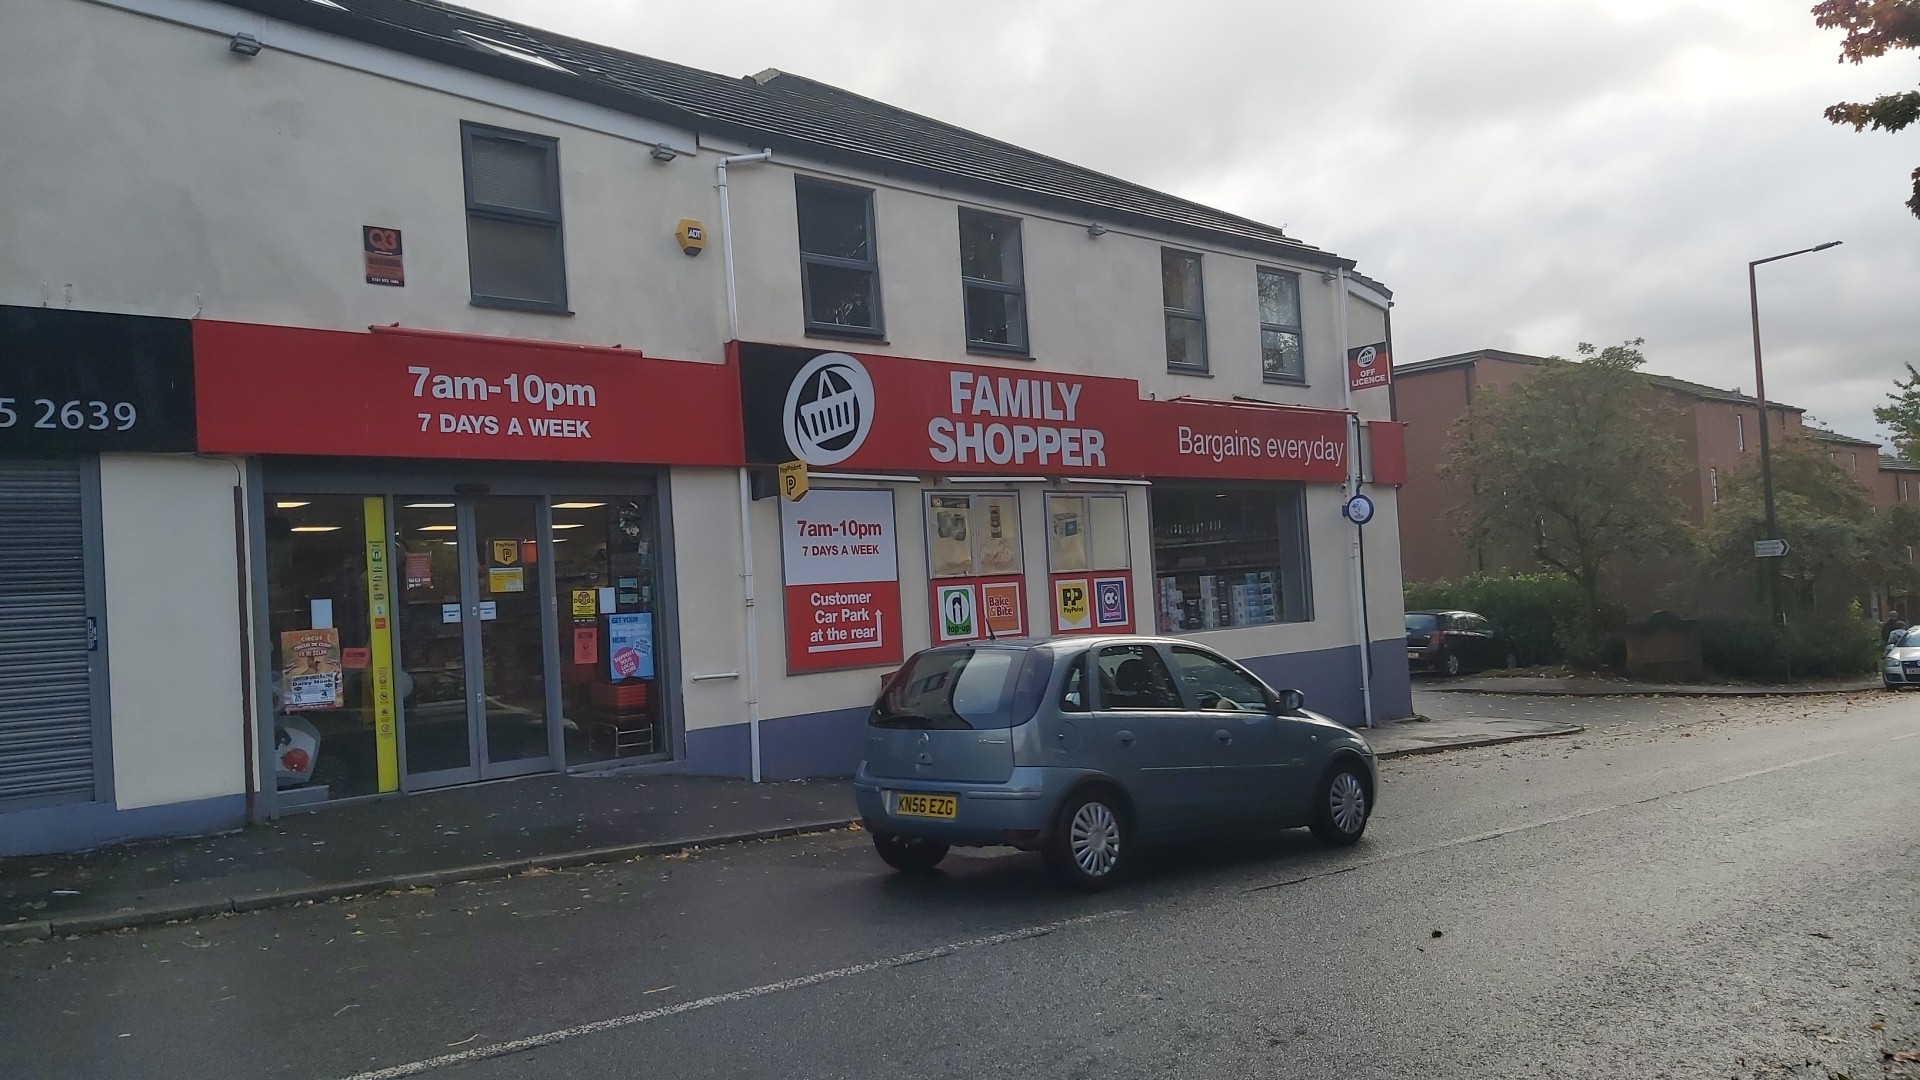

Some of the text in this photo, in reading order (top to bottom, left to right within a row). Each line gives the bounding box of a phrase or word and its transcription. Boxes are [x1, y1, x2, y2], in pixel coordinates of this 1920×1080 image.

[369, 228, 397, 250] Q3
[689, 229, 701, 238] ADT
[1352, 374, 1386, 387] LICENCE
[1360, 368, 1376, 378] OFF
[408, 366, 596, 411] 7am-10pm
[950, 371, 1082, 421] FAMILY
[34, 398, 137, 431] 2639
[418, 413, 592, 439] 7 DAYS A WEEK
[928, 416, 1106, 467] SHOPPER
[1178, 425, 1344, 467] Bargains everyday
[797, 519, 882, 539] 7am-10pm
[802, 544, 880, 556] 7 DAYS A WEEK
[810, 591, 872, 607] Customer
[989, 595, 1010, 606] Bake
[623, 616, 638, 624] YOUR
[815, 608, 870, 624] Car Park
[810, 626, 875, 643] at the rear
[948, 625, 971, 634] top-up
[612, 636, 626, 644] HERE
[898, 796, 953, 815] KN56 EZG
